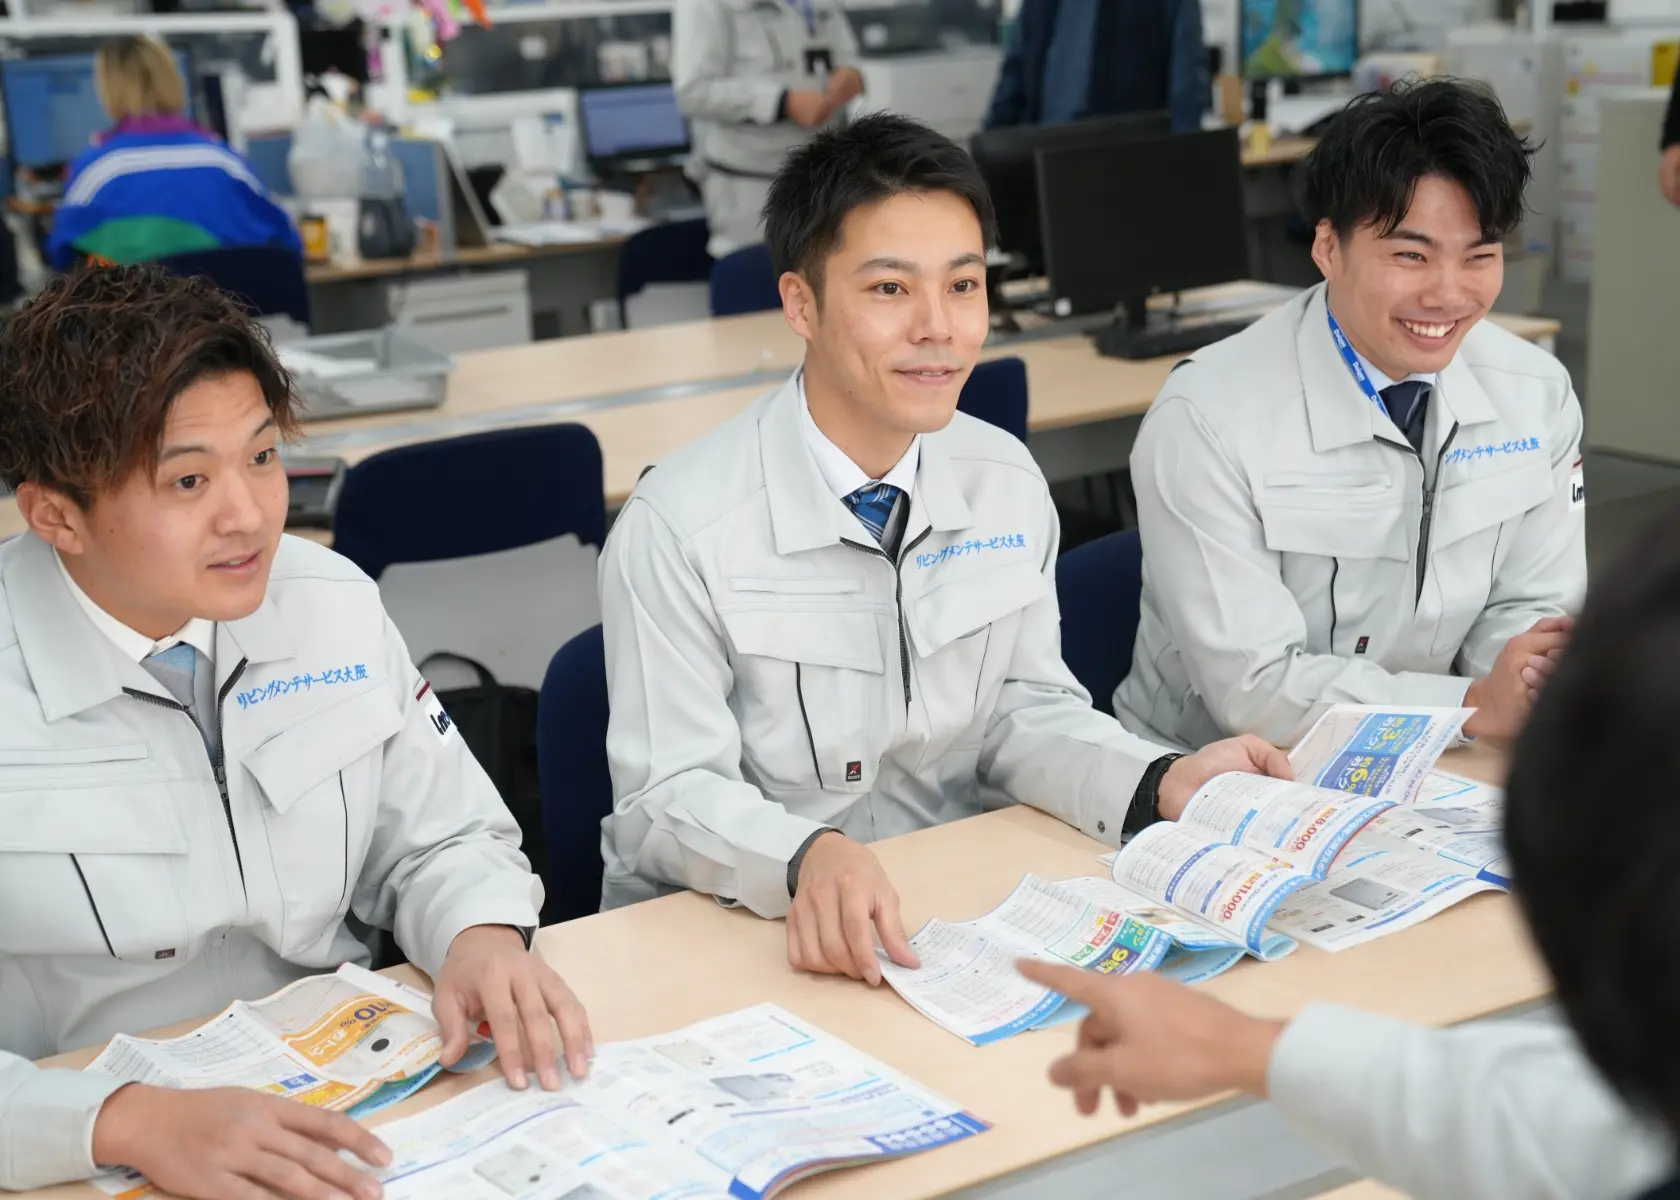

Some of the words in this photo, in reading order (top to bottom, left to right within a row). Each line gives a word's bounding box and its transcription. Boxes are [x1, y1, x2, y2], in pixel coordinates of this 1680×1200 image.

[916, 533, 1027, 569] リビングメンテサービス大阪
[236, 664, 370, 710] リビングメンテサービス大阪
